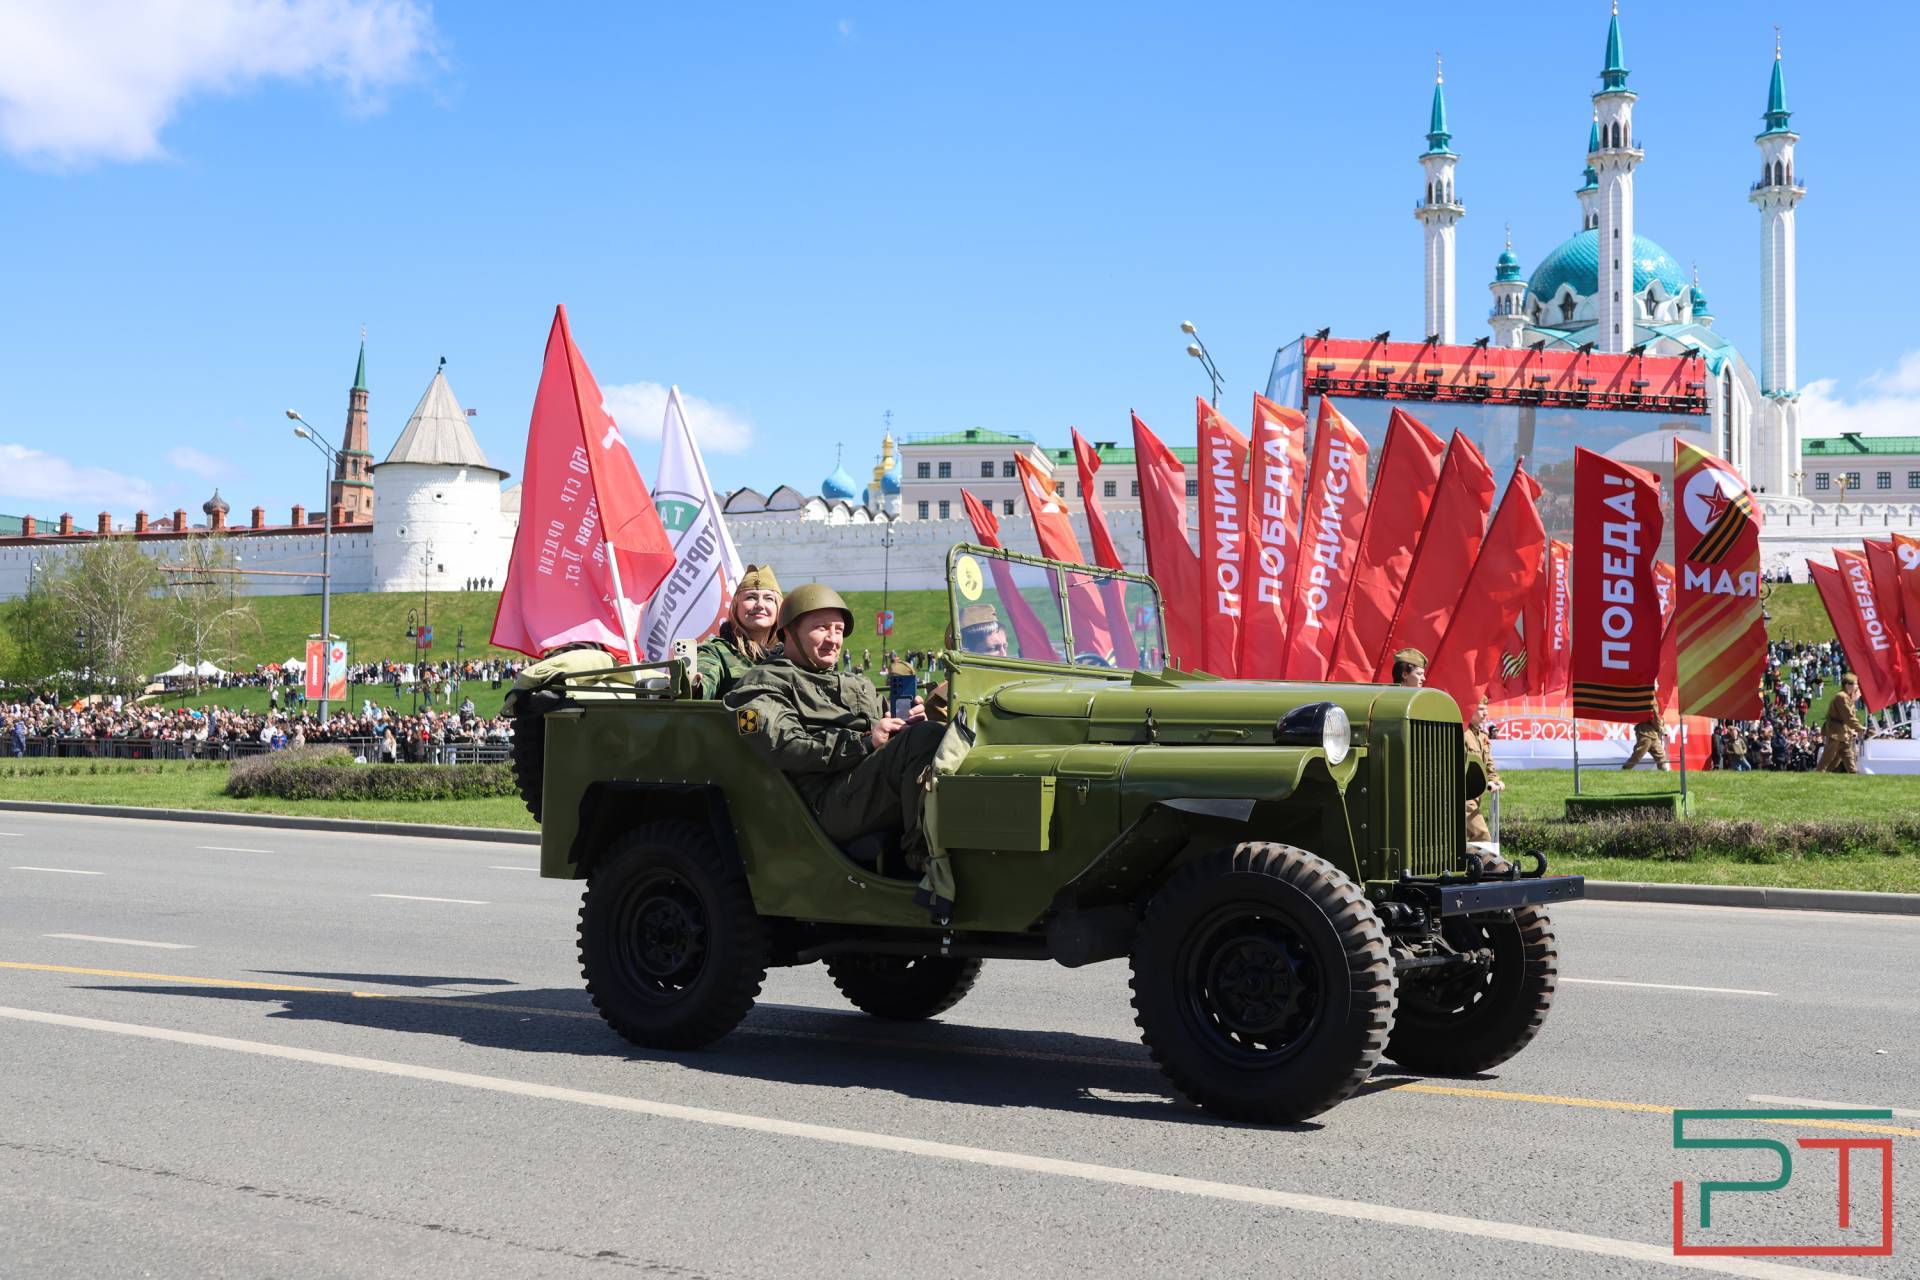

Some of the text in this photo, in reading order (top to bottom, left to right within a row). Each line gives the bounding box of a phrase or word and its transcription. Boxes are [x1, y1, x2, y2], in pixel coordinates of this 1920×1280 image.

[1210, 436, 1242, 617] ПОМНИМ!
[1257, 420, 1292, 606] ПОБЕДА!
[1304, 438, 1354, 629] ГОРДИМСЯ!
[1601, 473, 1641, 670] ПОБЕДА!
[1684, 564, 1757, 597] МАЯ
[1844, 559, 1890, 652] ПОБЕДА!
[1603, 723, 1689, 744] ЖУ!
